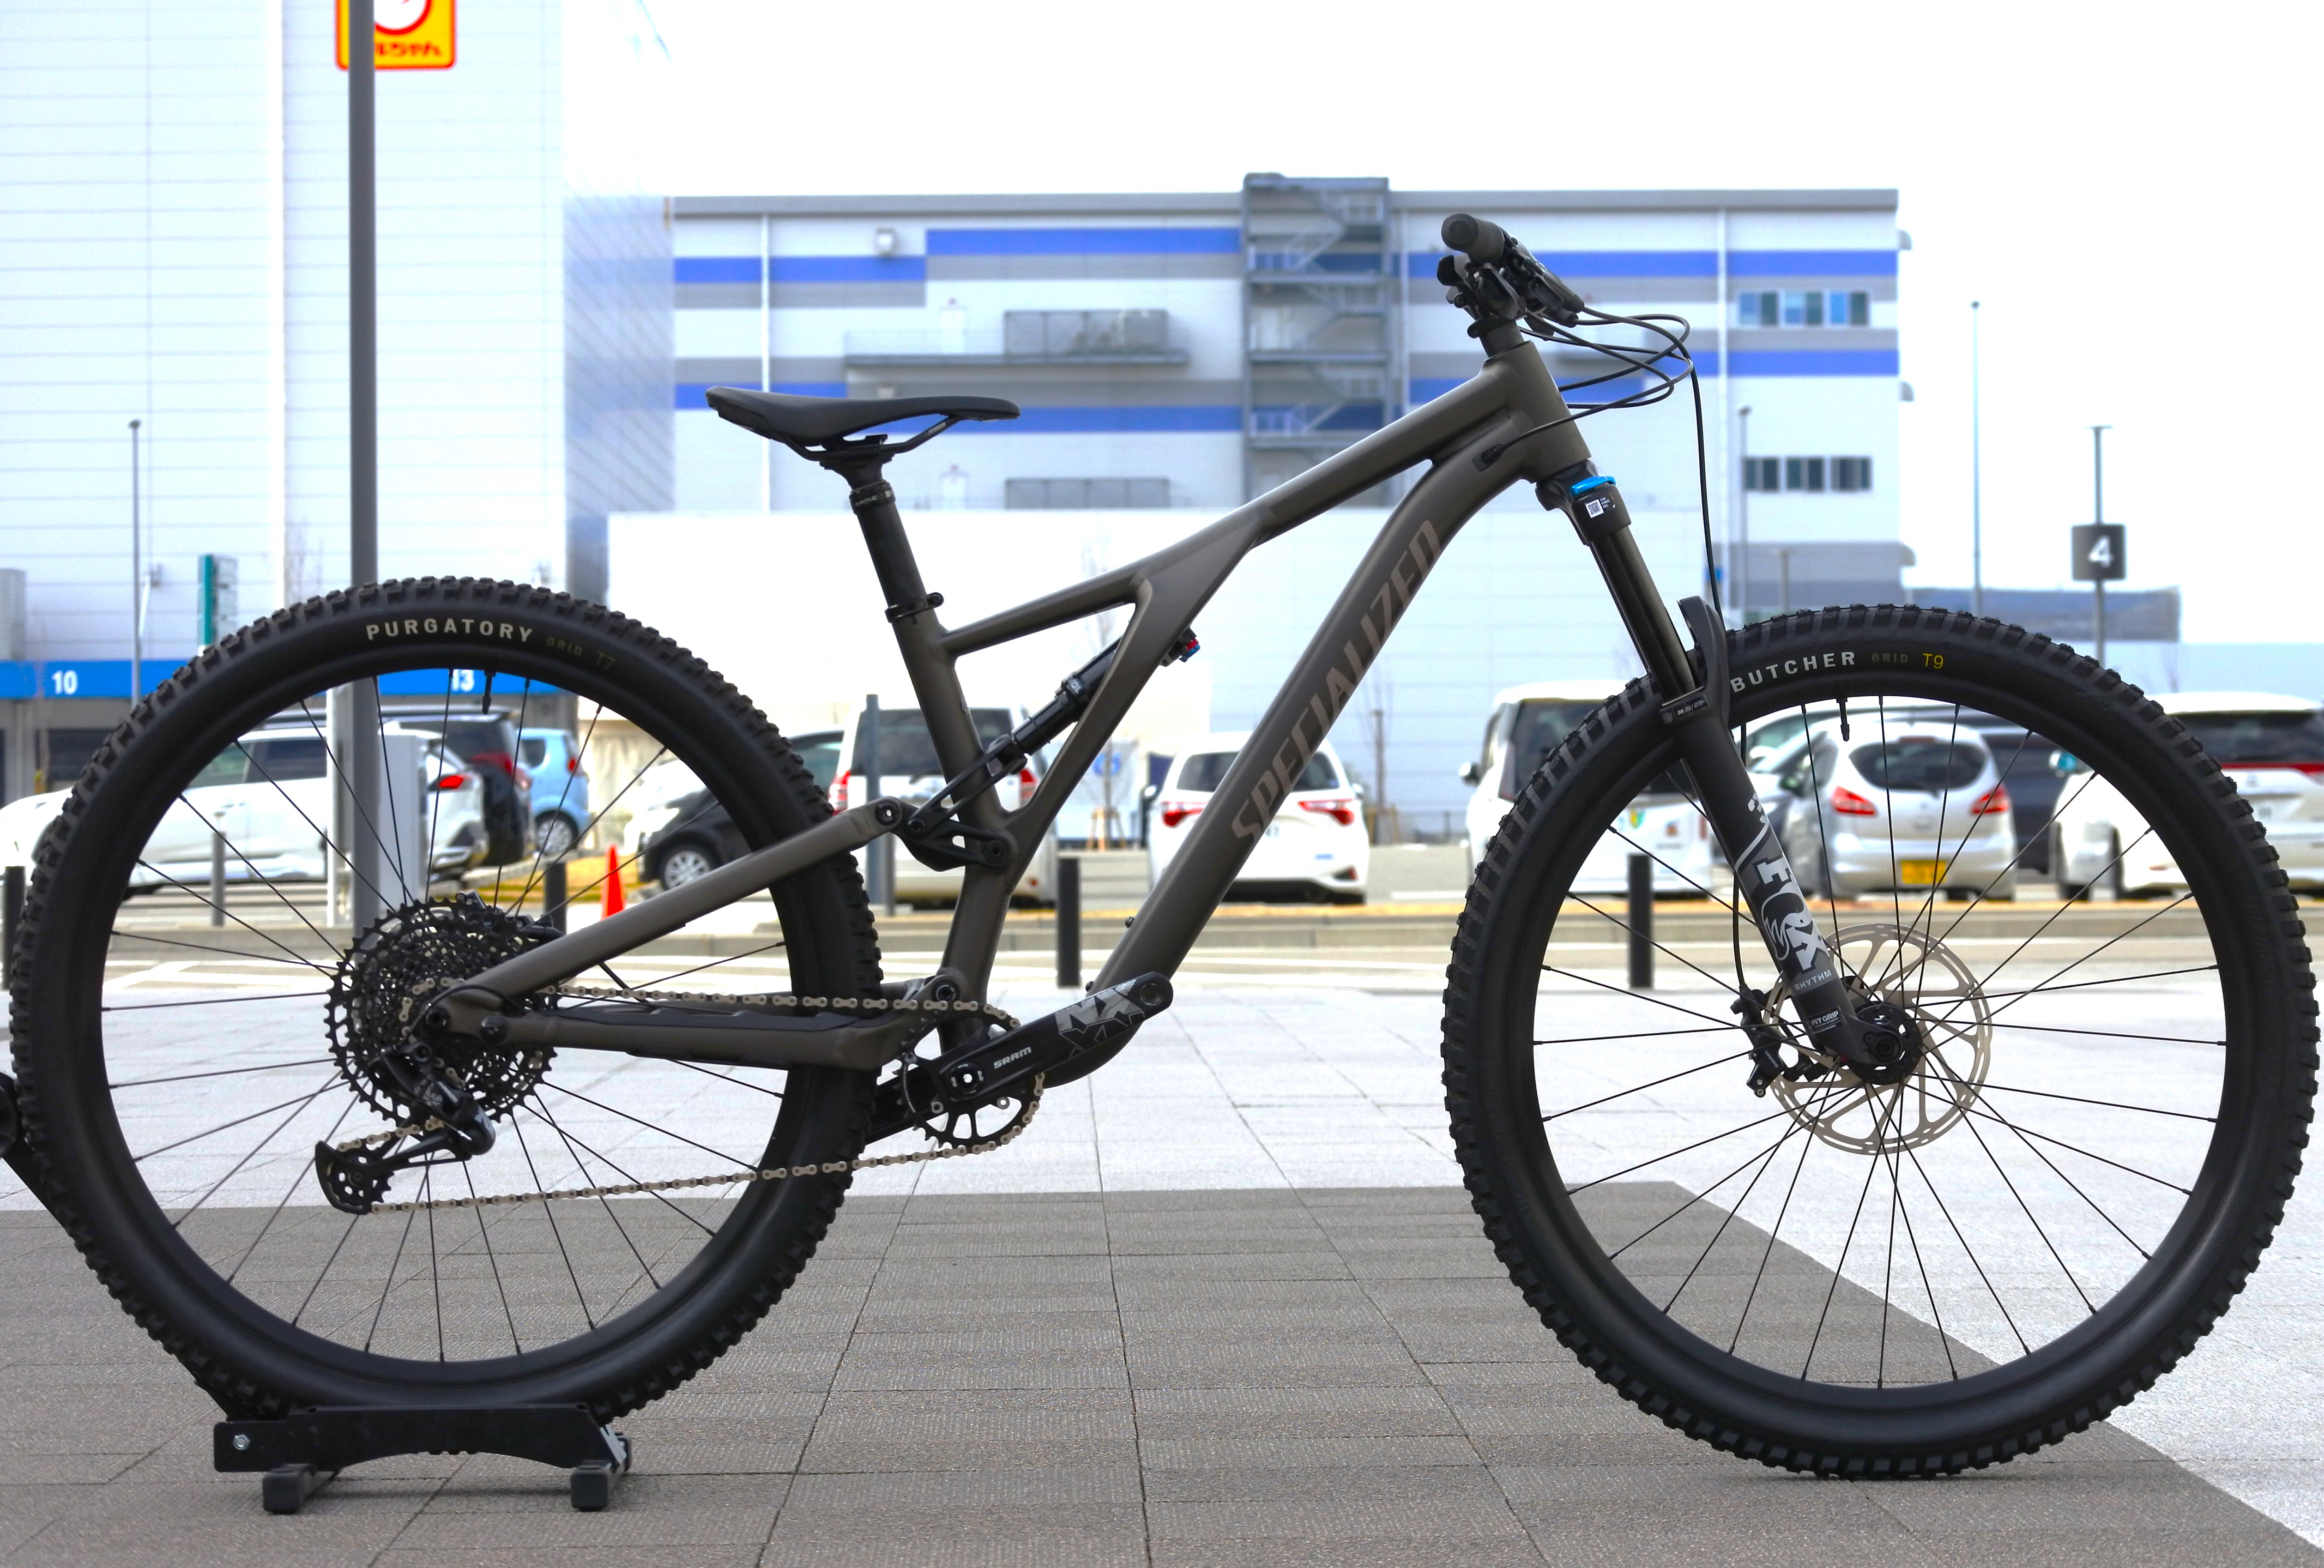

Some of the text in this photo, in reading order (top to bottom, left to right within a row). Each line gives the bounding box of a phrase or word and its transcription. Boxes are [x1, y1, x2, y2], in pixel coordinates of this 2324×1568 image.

[2088, 534, 2114, 568] 4
[366, 618, 616, 669] PURGATORY GRID T7
[51, 670, 78, 695] 10
[452, 669, 475, 692] 13
[1231, 519, 1443, 843] SPECIALIZED
[1730, 651, 1944, 693] BUTCHER GRID T9
[1757, 856, 1829, 970] FOX
[1794, 970, 1832, 991] RHYTHM
[1055, 979, 1143, 1033] NX
[1822, 1011, 1838, 1022] GRIP
[994, 1047, 1032, 1069] SRAM
